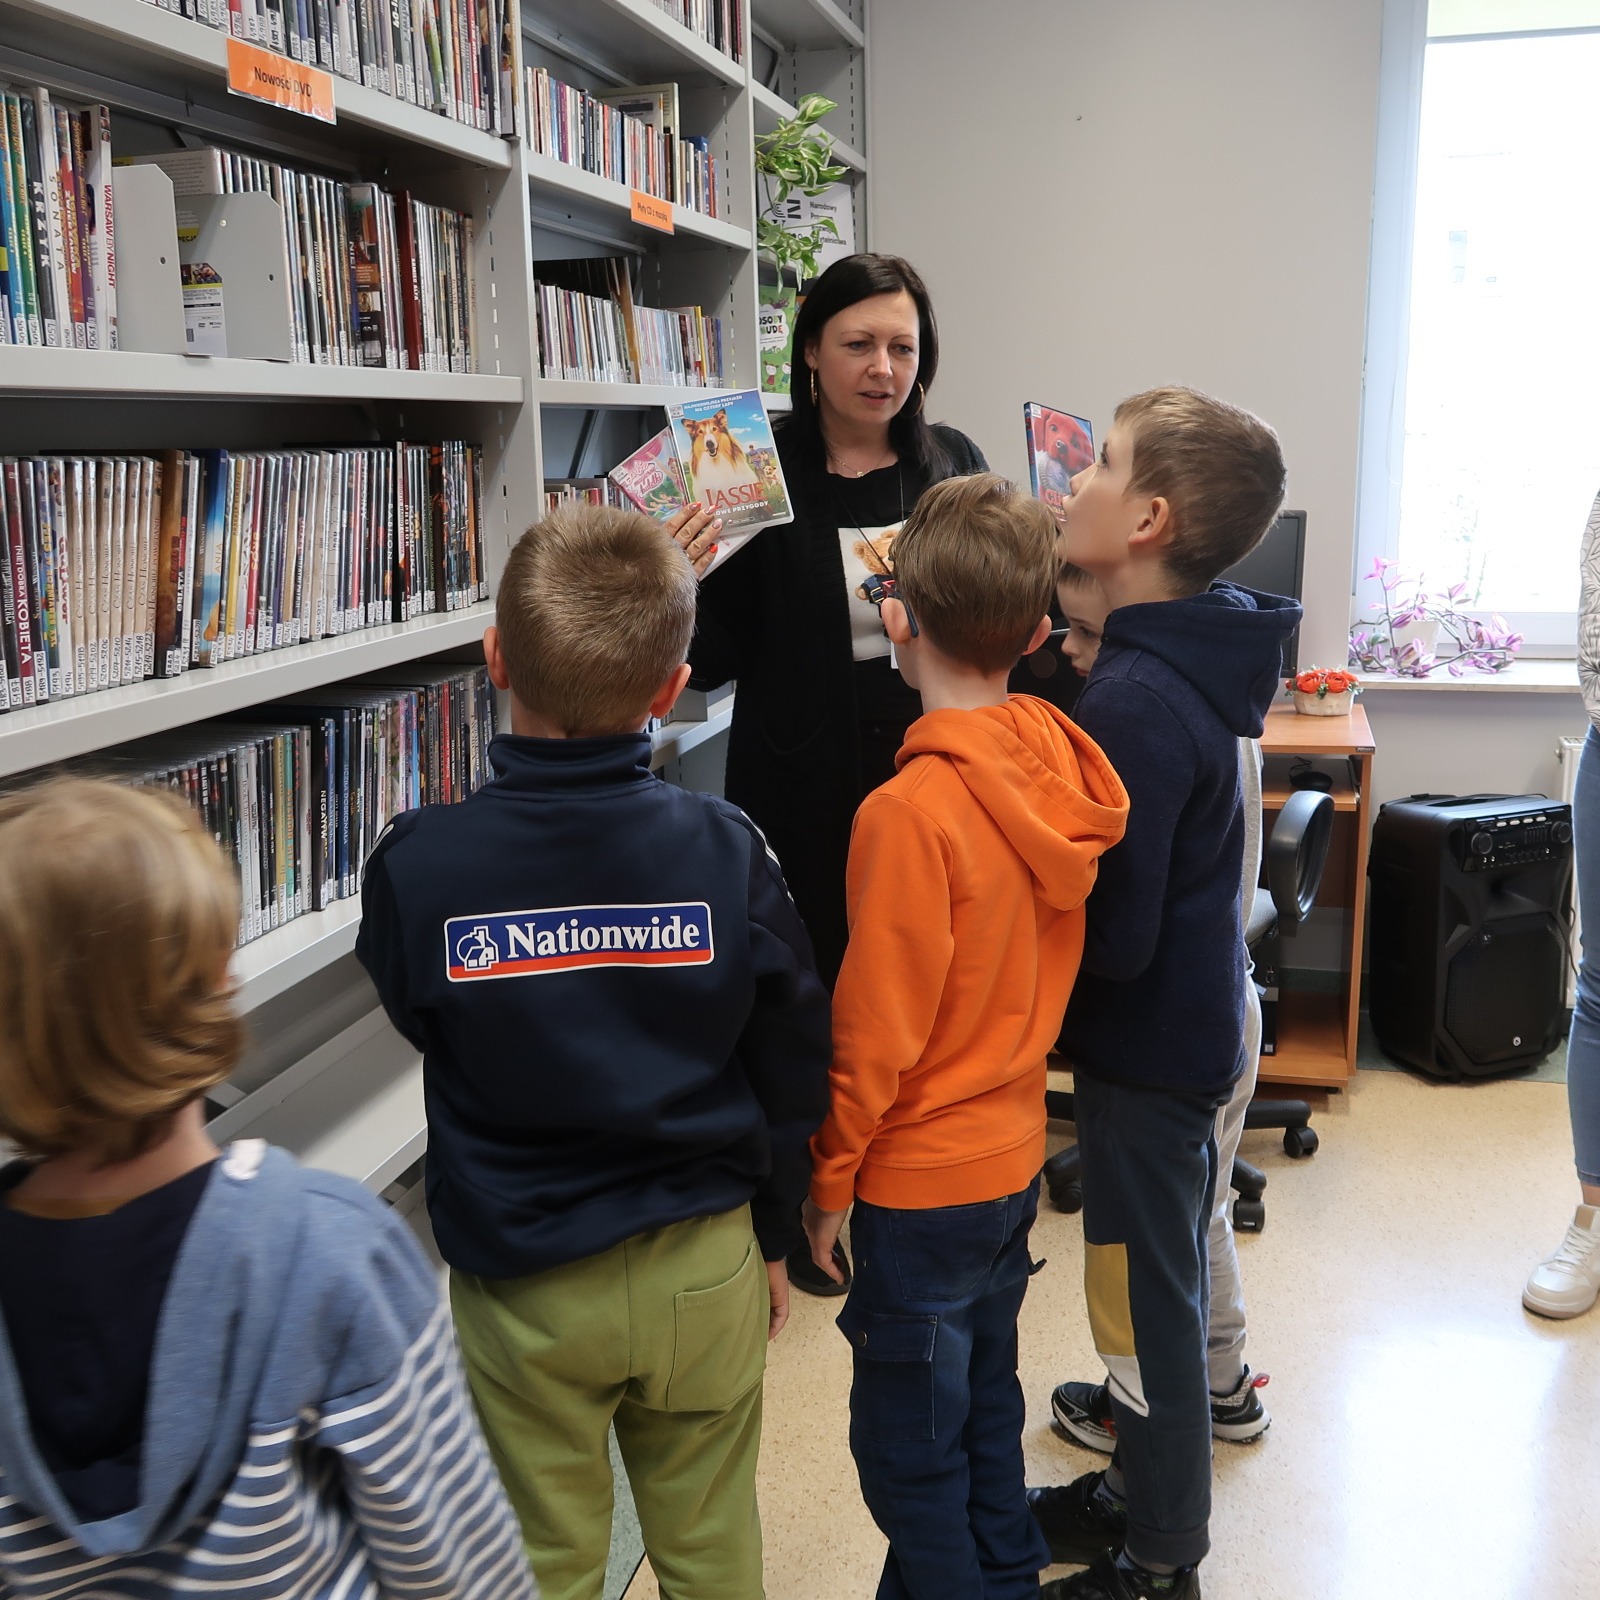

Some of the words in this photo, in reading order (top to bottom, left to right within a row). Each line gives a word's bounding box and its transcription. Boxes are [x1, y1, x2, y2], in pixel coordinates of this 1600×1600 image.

[254, 66, 292, 91] Nowości
[293, 80, 312, 97] DVD
[104, 184, 114, 236] WARSAW
[810, 201, 837, 213] Narodowy
[33, 181, 51, 268] KRZYK
[49, 176, 65, 270] SONATA
[106, 237, 114, 252] BY
[107, 252, 116, 288] NIGHT
[17, 320, 26, 344] 5055
[32, 321, 40, 345] 5056
[47, 323, 56, 345] 5057
[77, 324, 85, 347] 5060
[88, 325, 97, 347] 5061
[705, 482, 767, 510] LASSIE
[732, 500, 768, 514] PRZYGODY
[14, 545, 23, 565] (NIE)
[214, 543, 222, 575] ANIA
[16, 567, 25, 597] DOBRA
[176, 571, 184, 612] ORLĘTA
[17, 599, 31, 664] KOBIETA
[10, 679, 21, 703] 5187
[64, 671, 73, 693] 5194
[505, 915, 700, 959] Nationwide
